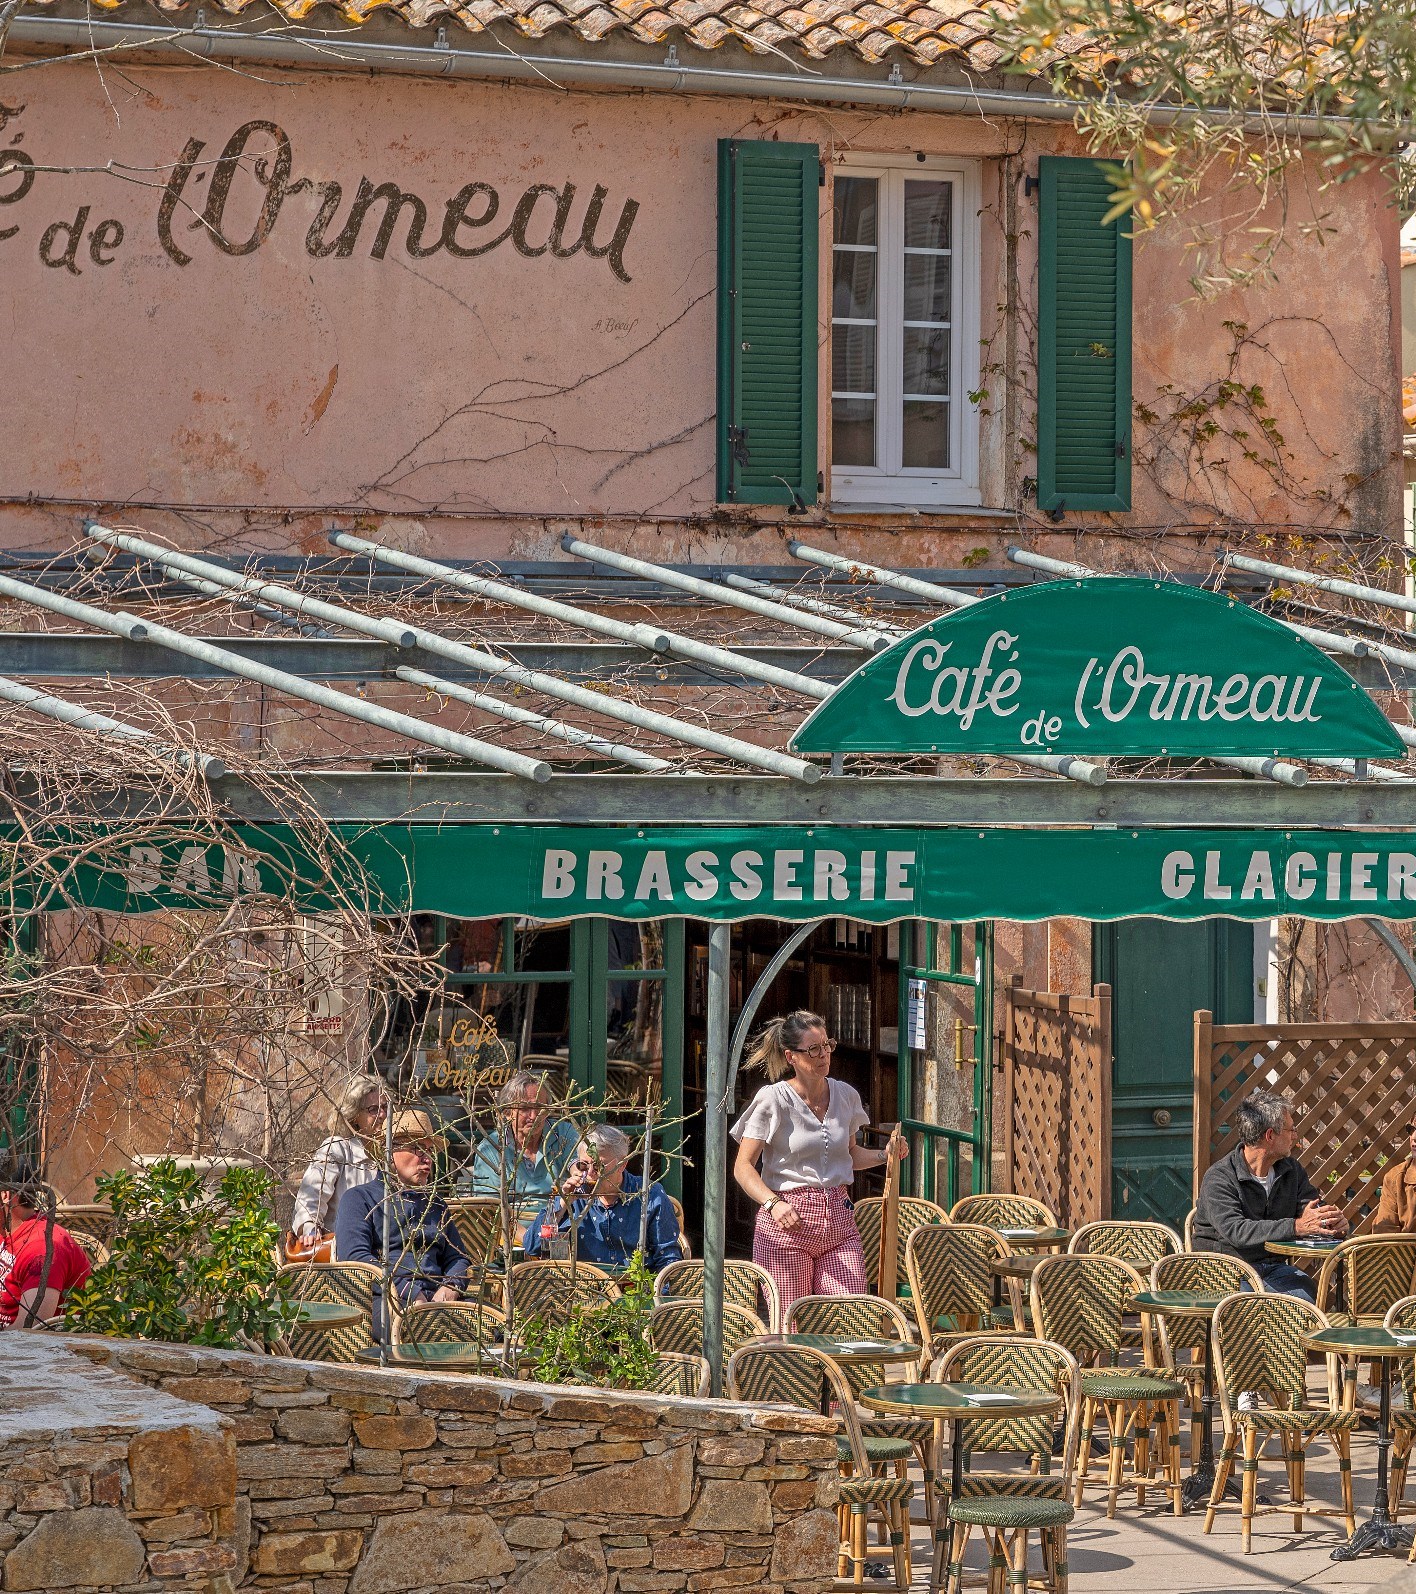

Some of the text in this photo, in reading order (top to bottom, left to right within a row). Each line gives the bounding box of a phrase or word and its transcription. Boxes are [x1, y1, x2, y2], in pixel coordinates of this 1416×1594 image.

[38, 205, 125, 276] de
[157, 119, 640, 284] l'Ormeau
[884, 630, 1323, 746] Café de l'Ormeau
[127, 846, 264, 894] BAR
[541, 848, 916, 902] BRASSERIE
[447, 1014, 498, 1051] Café
[424, 1059, 518, 1090] lOrmeau
